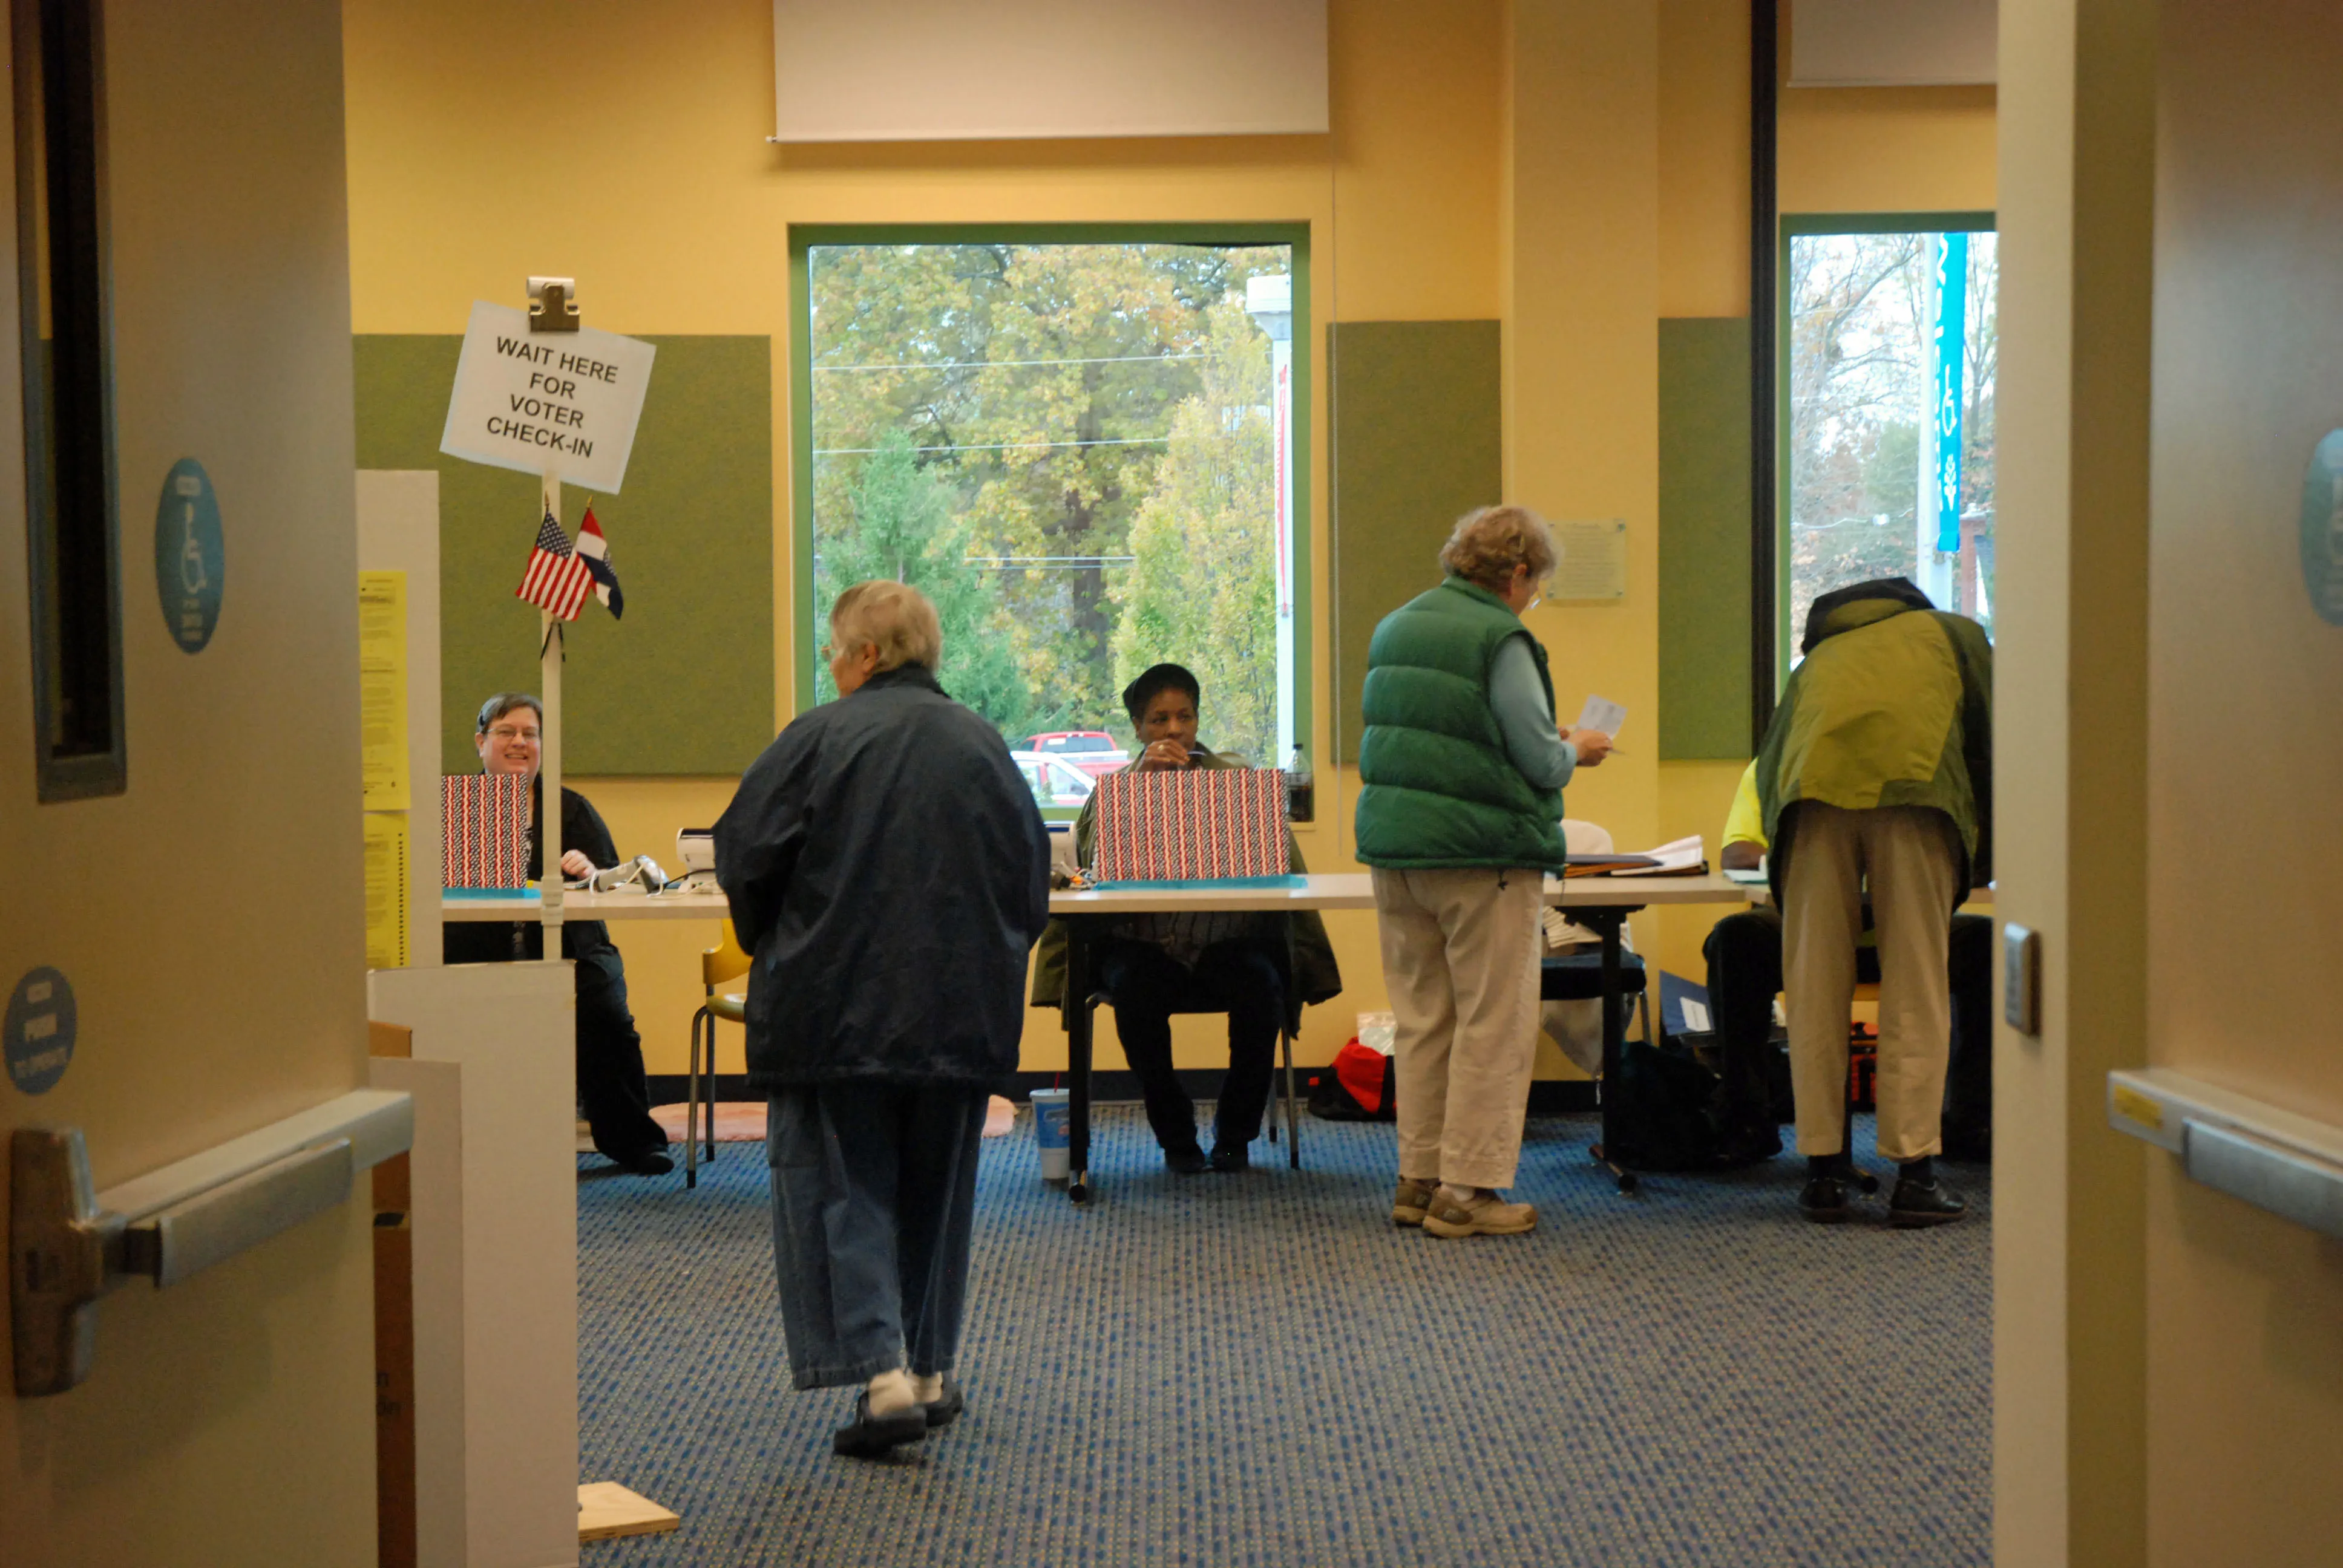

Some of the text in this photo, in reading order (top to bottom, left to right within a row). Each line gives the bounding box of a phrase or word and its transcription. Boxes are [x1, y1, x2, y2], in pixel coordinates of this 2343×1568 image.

[497, 336, 618, 384] WAIT HERE
[529, 372, 575, 399] FOR
[511, 394, 584, 429] VOTER
[487, 416, 593, 458] CHECK-IN
